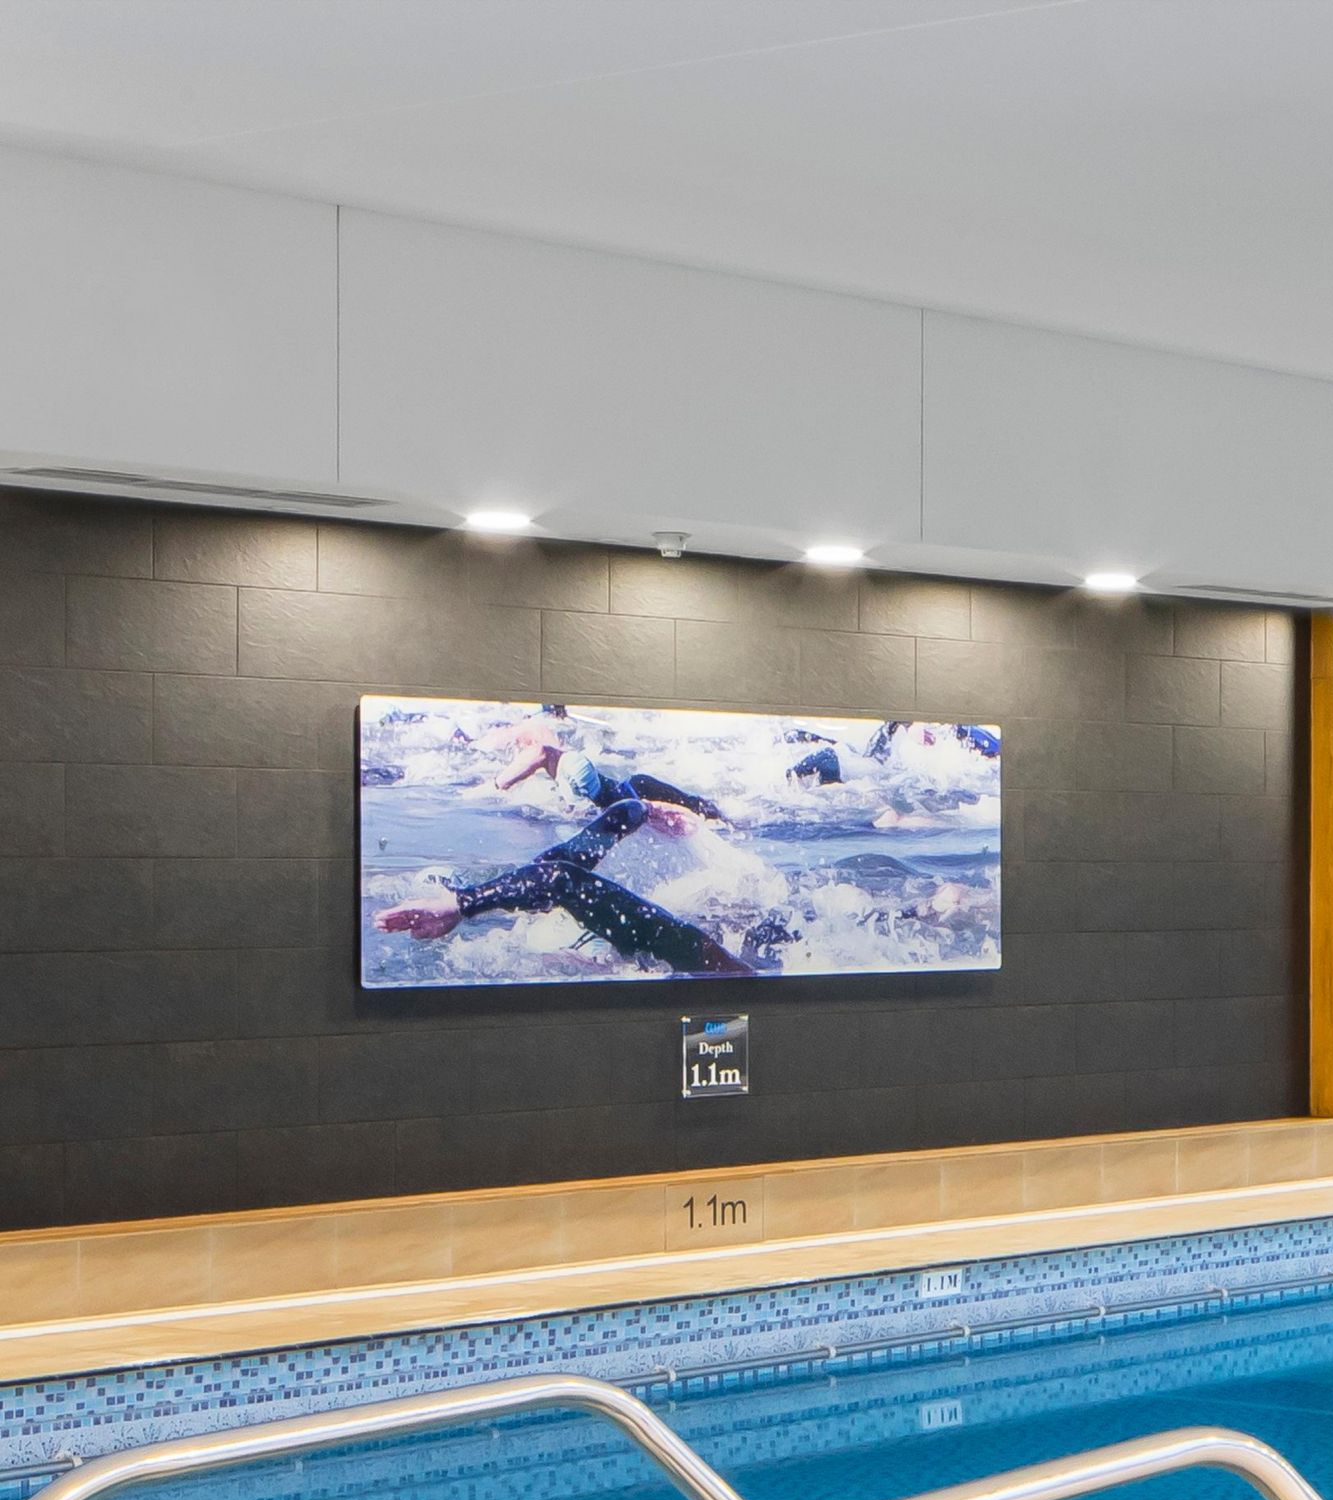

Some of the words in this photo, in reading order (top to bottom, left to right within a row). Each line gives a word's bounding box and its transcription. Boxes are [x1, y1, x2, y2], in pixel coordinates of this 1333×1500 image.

[698, 1041, 734, 1059] Depth
[690, 1062, 742, 1087] 1.1m
[682, 1194, 747, 1229] 1.1m
